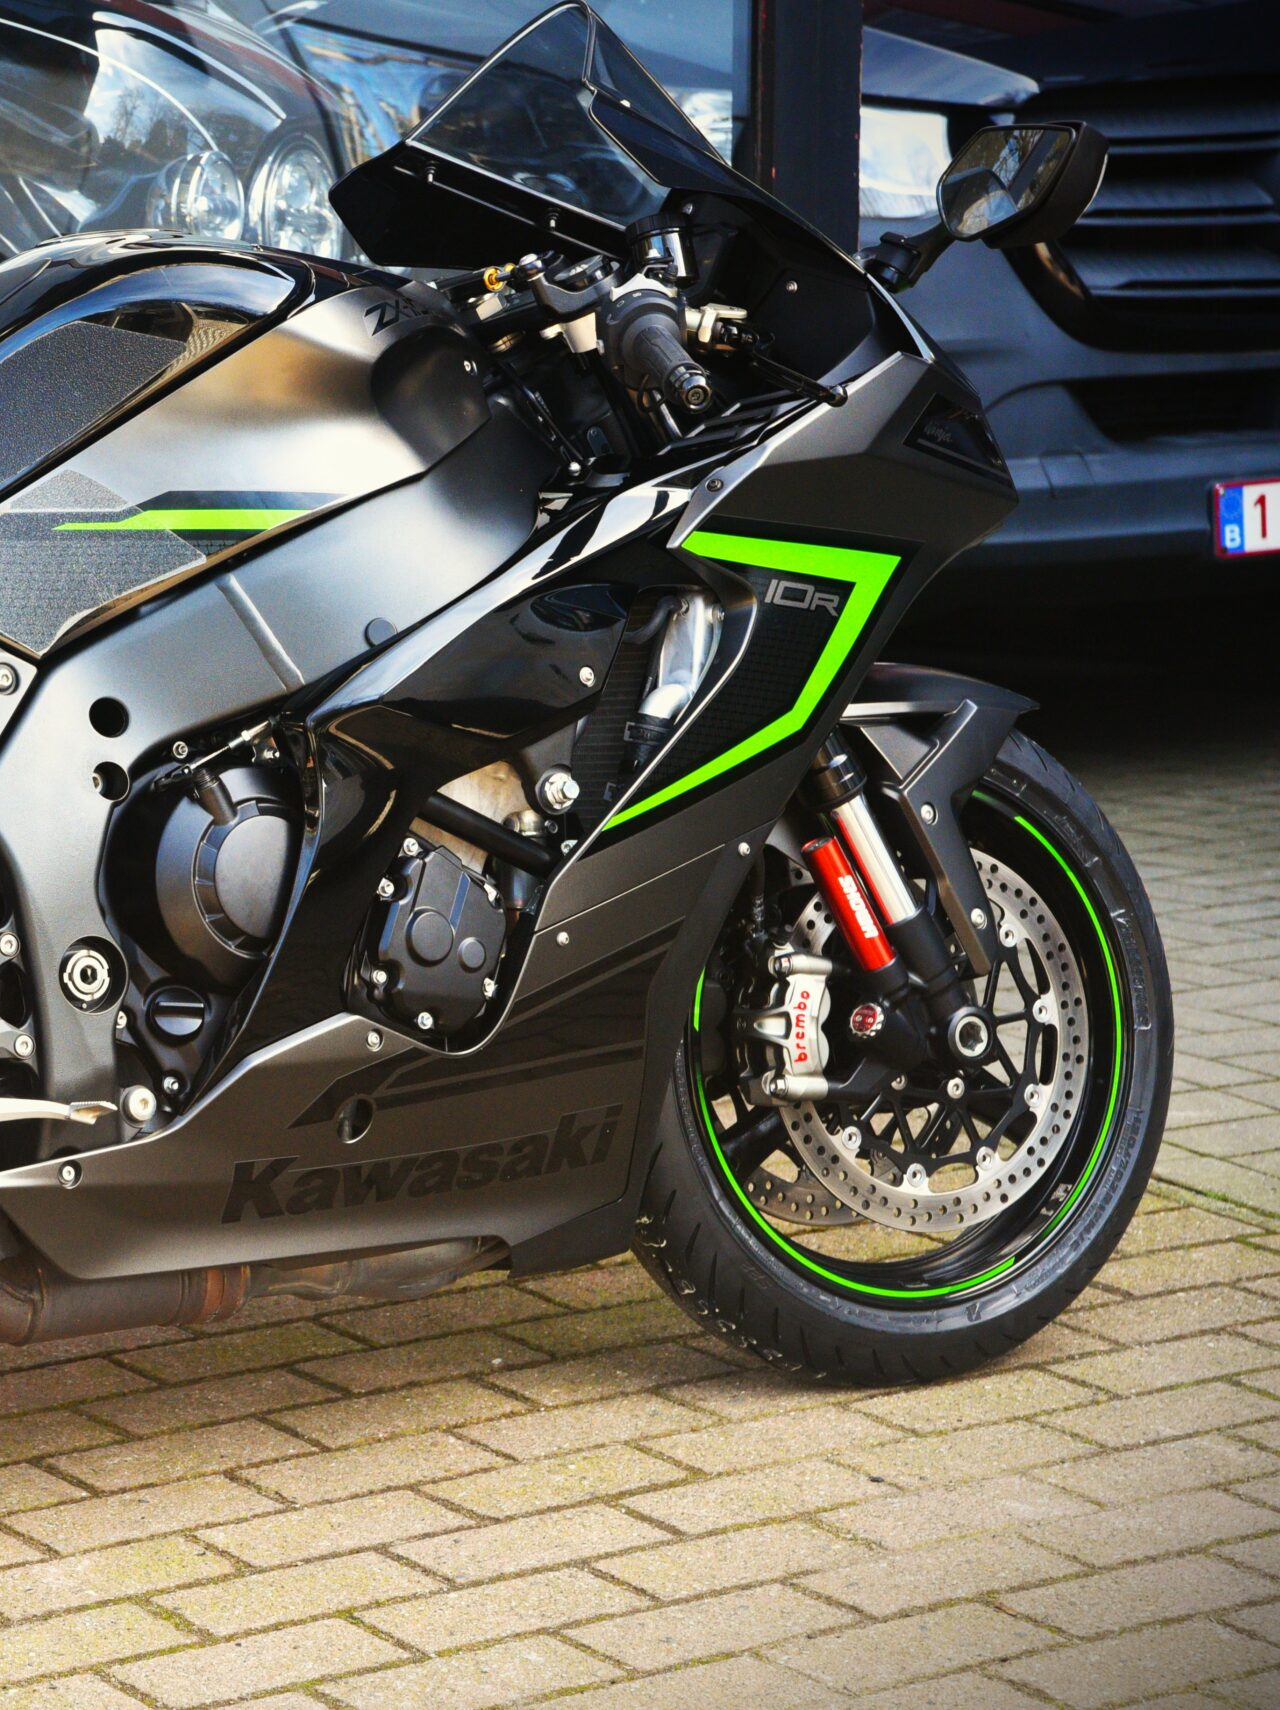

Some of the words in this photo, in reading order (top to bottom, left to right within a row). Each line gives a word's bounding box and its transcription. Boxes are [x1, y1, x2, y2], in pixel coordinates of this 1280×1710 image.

[1225, 523, 1241, 549] B
[1253, 493, 1267, 540] 1
[764, 578, 840, 617] 10R
[838, 874, 879, 939] SHOWA
[794, 990, 811, 1064] brembo
[221, 1103, 623, 1225] Kawasaki
